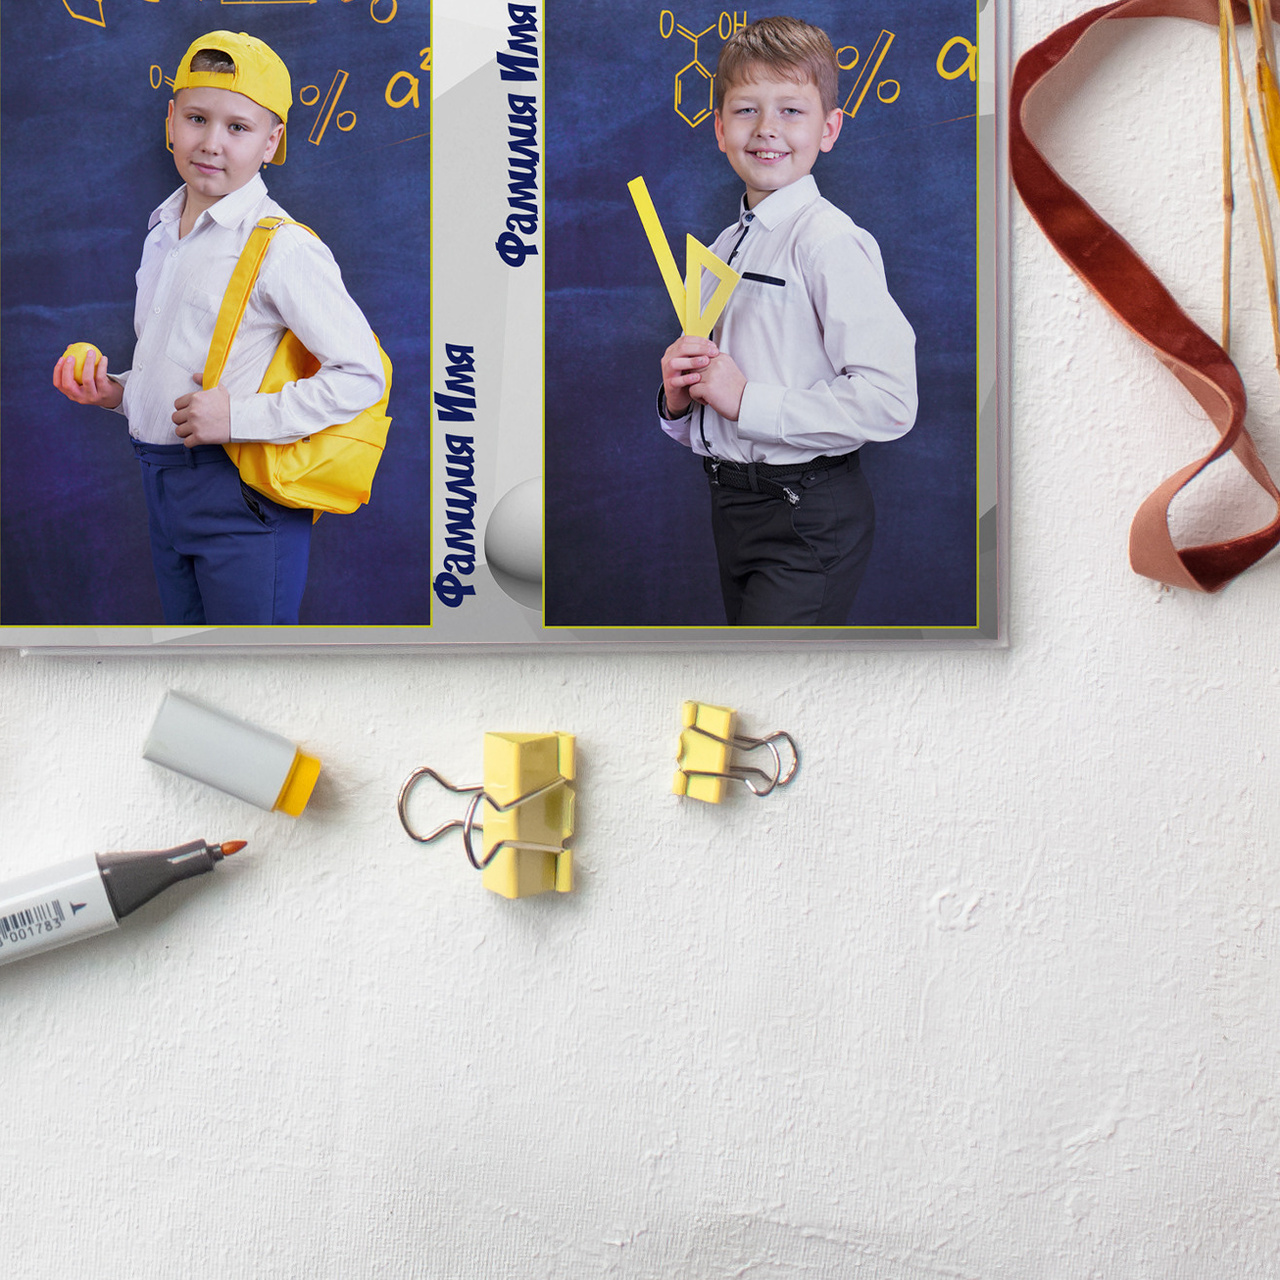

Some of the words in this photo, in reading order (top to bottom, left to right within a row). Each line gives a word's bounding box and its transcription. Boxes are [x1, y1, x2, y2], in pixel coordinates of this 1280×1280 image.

[496, 2, 540, 82] Имя
[495, 93, 540, 268] Фамилия
[433, 343, 477, 422] Имя
[433, 433, 477, 608] Фамилия
[9, 915, 63, 943] 001783
